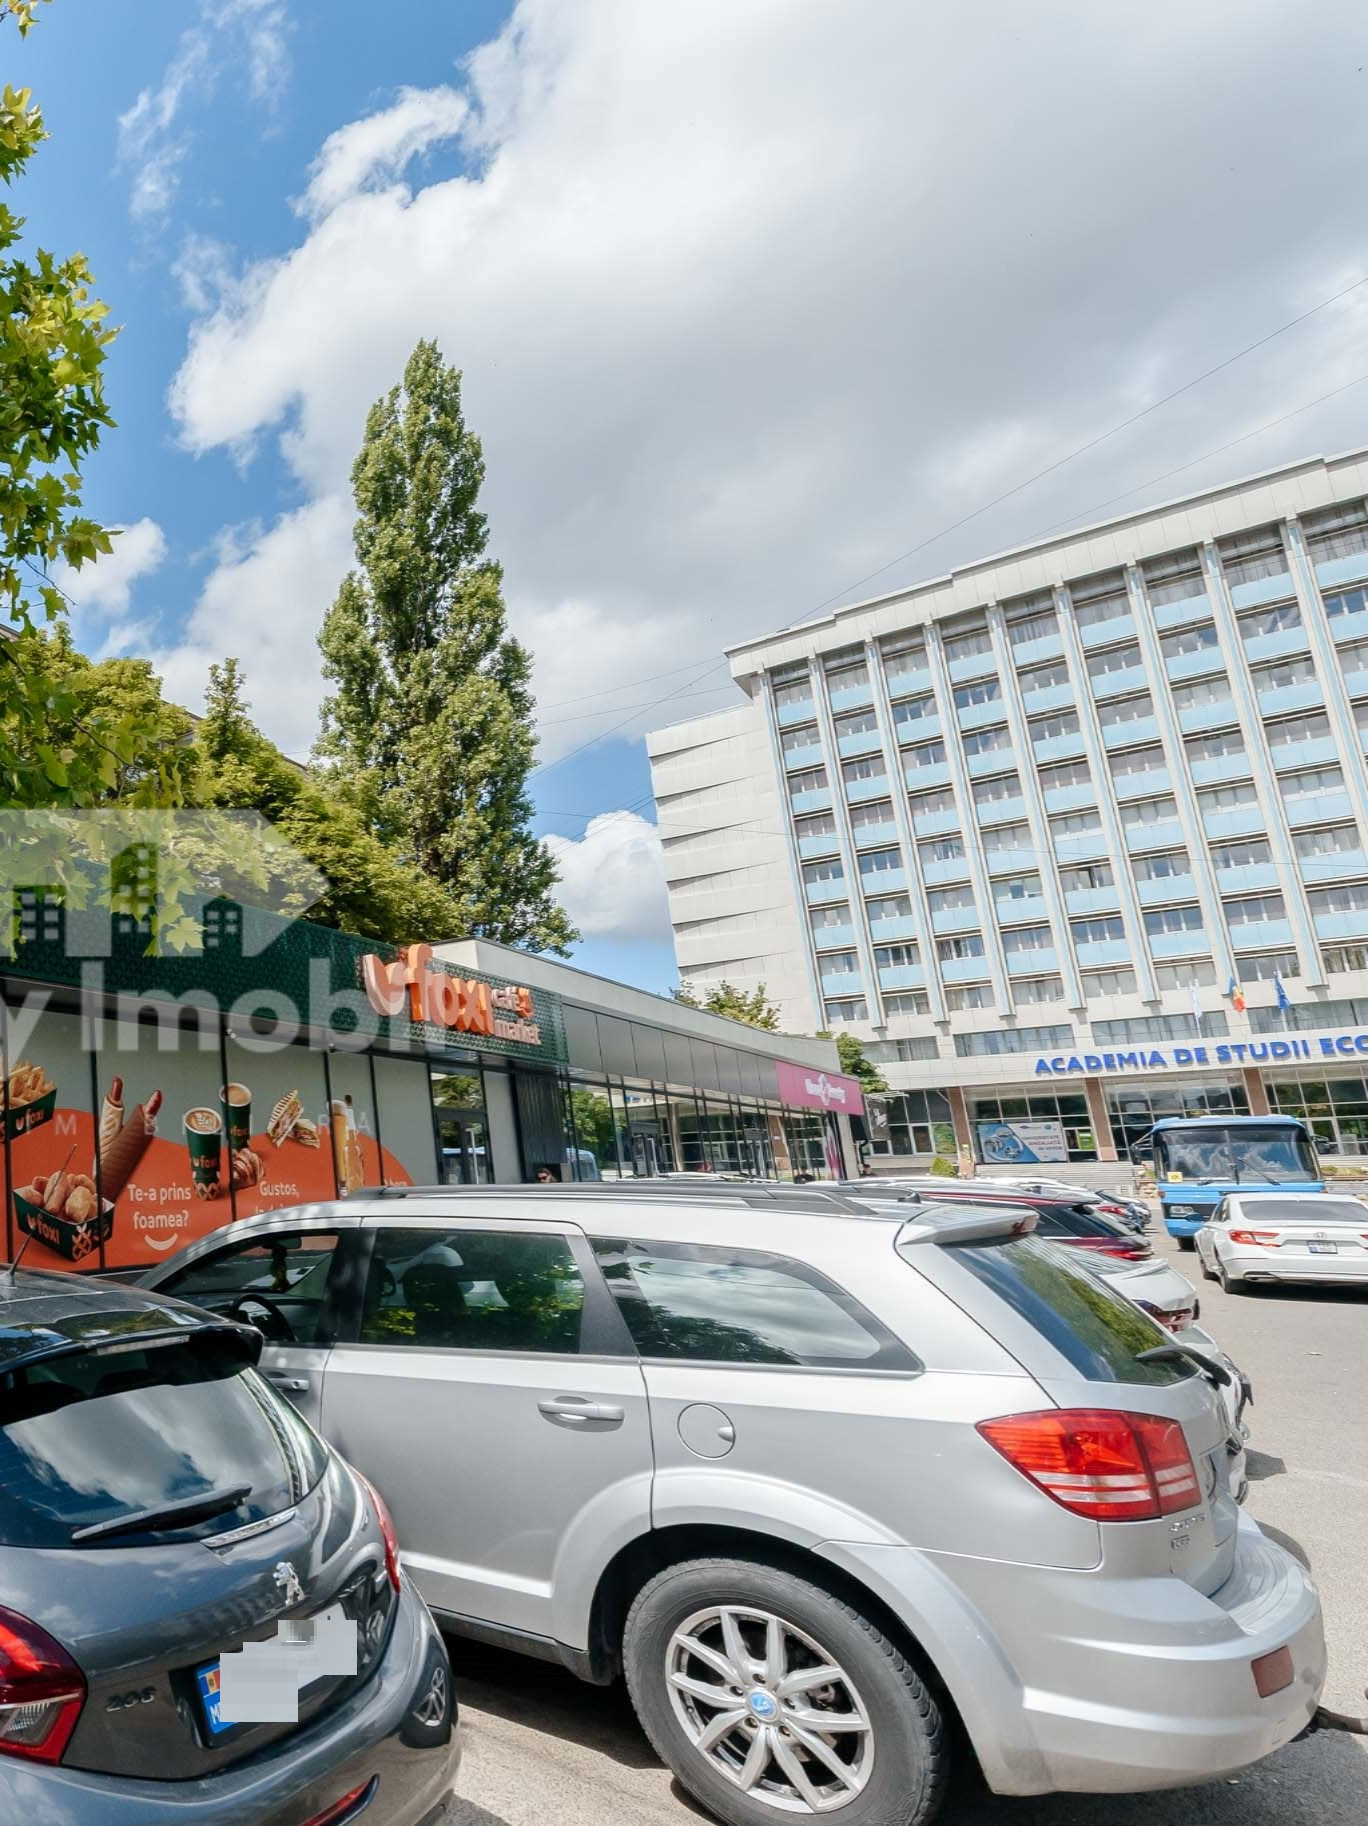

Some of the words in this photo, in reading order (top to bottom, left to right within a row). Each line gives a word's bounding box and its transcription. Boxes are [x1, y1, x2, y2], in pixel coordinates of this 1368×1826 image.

[493, 1018, 541, 1046] market
[1034, 1050, 1168, 1074] ACADEMIA
[1173, 1047, 1209, 1066] DE
[1215, 1040, 1311, 1063] STUDII
[127, 1183, 157, 1202] Te-a
[160, 1183, 192, 1205] prins
[259, 1180, 300, 1199] Gustos,
[133, 1209, 189, 1230] foamea?
